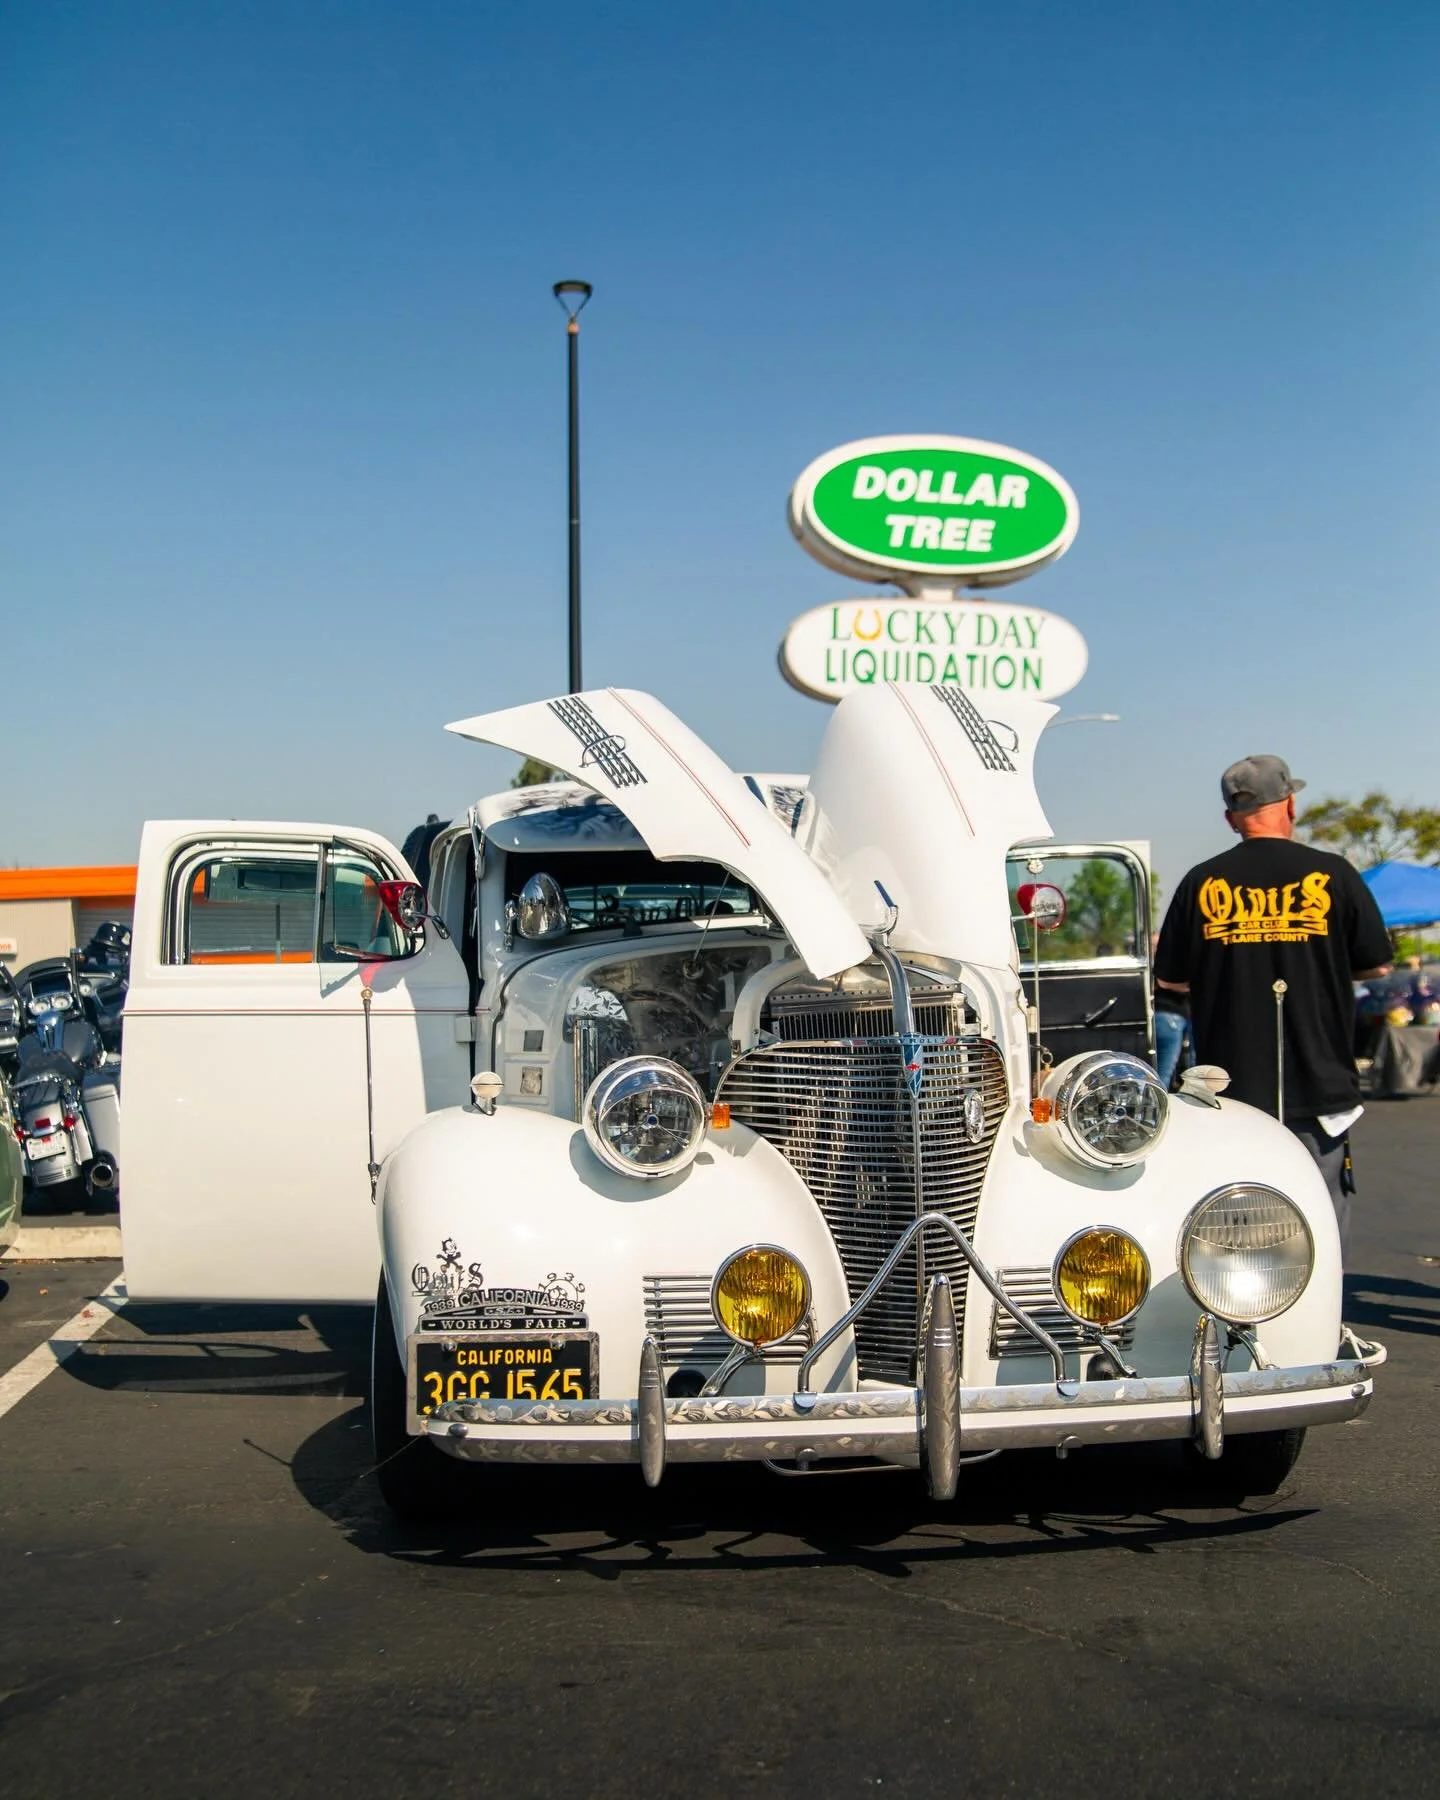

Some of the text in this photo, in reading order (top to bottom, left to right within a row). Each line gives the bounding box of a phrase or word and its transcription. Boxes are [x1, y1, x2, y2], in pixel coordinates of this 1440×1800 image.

[852, 466, 1029, 508] DOLLAR
[885, 514, 996, 552] TREE
[830, 607, 1046, 649] LUCKY DAY
[825, 648, 1042, 691] LIQUIDATION
[1222, 933, 1309, 945] TLARE COUNTY
[1238, 920, 1290, 930] CAR CLUB
[425, 1299, 455, 1313] 1939
[459, 1289, 551, 1308] CALIFORNIA
[556, 1299, 583, 1312] 1939
[441, 1318, 567, 1329] WORLD'S FAIR
[457, 1349, 553, 1366] CALIFORNIA
[506, 1368, 584, 1400] 1565
